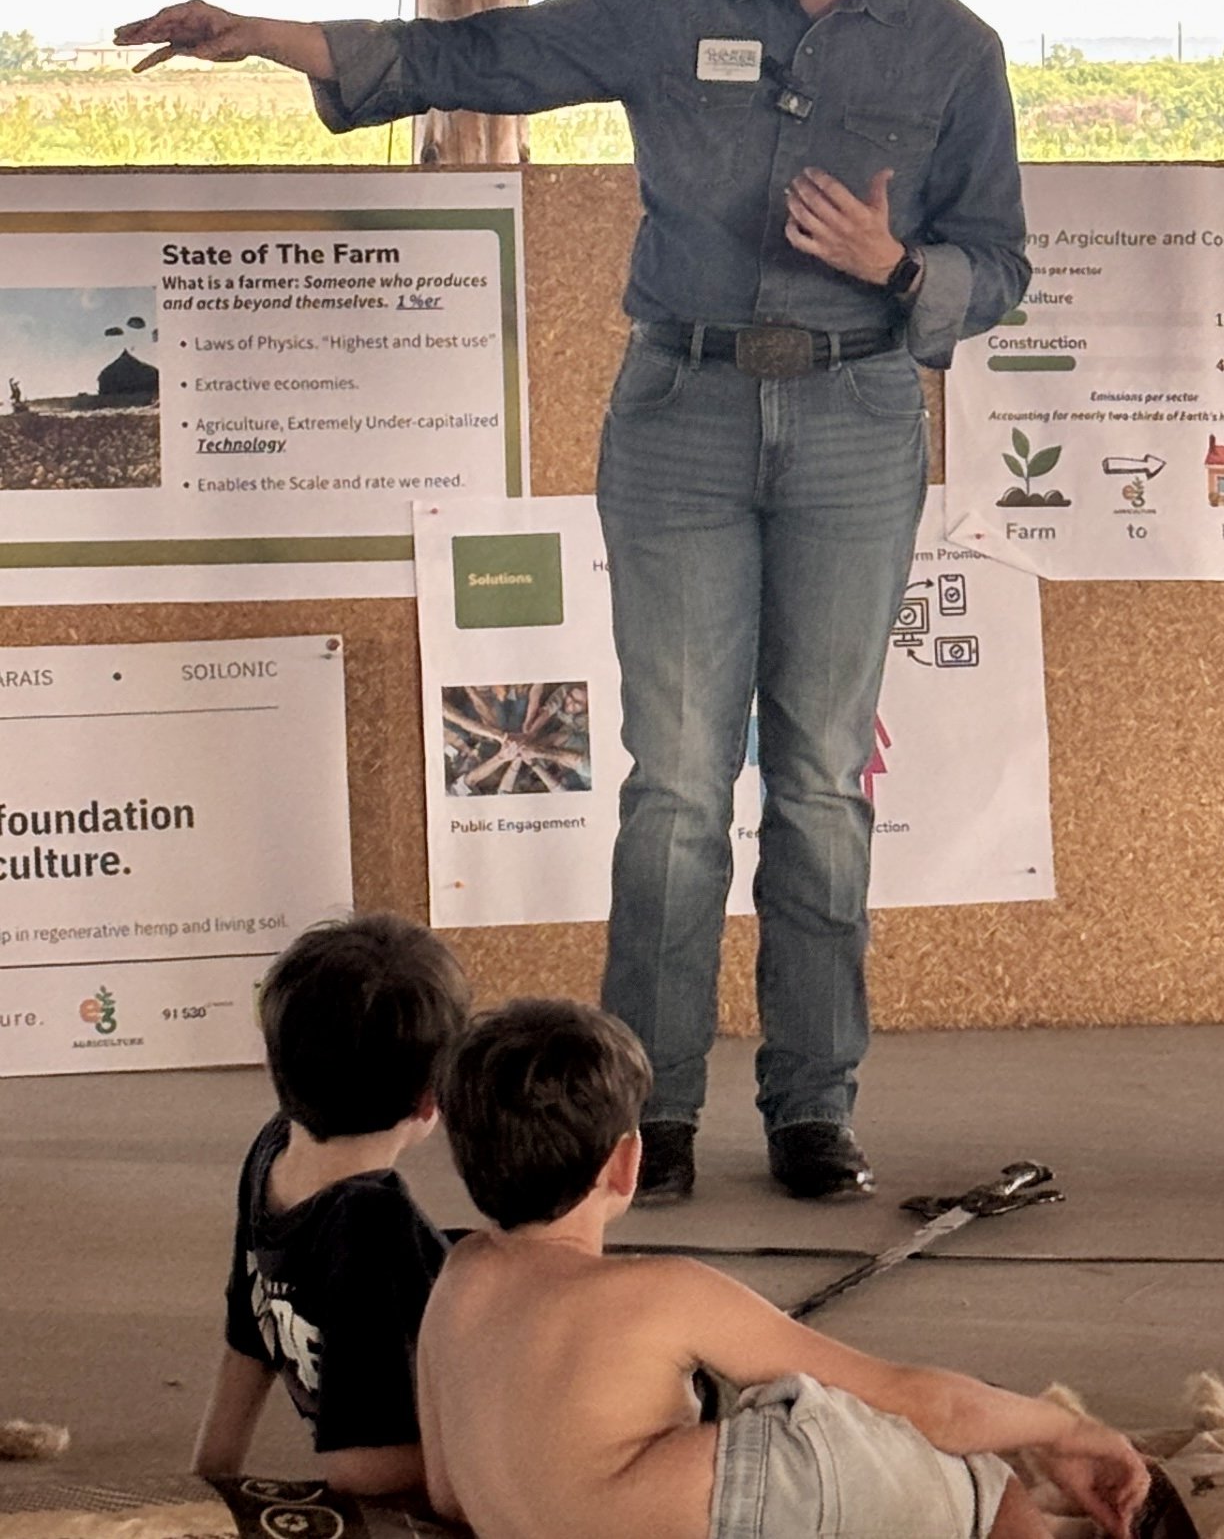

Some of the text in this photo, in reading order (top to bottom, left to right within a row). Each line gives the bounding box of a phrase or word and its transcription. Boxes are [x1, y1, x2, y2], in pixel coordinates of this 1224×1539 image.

[1055, 230, 1157, 249] Argiculture
[1162, 230, 1196, 247] and
[162, 243, 400, 265] State of The Farm
[1069, 265, 1103, 275] sector
[162, 274, 487, 291] What is a farmer: Someone who produces
[163, 296, 194, 311] and
[196, 297, 229, 310] acts
[233, 295, 291, 312] beyond
[295, 295, 389, 310] themselves.
[195, 337, 235, 351] Laws
[237, 336, 254, 351] of
[257, 336, 318, 354] Physics.
[392, 335, 421, 349] and
[425, 335, 459, 349] best
[988, 335, 1087, 350] Construction
[195, 377, 359, 392] Extractive economies.
[1090, 391, 1199, 405] Emissions per sector
[196, 413, 499, 436] Agriculture, Extremely Under-capitalized
[988, 410, 1050, 423] Accounting
[1052, 409, 1069, 423] for
[1071, 410, 1106, 423] nearly
[1166, 410, 1180, 422] of
[196, 438, 287, 454] Technology
[198, 474, 465, 492] Enables the Scale and rate we need.
[1006, 523, 1056, 541] Farm
[1127, 524, 1148, 540] to
[468, 572, 533, 587] Solutions
[182, 661, 278, 681] SOILONIC
[451, 816, 586, 834] Public Engagement
[15, 927, 30, 942] in
[34, 923, 130, 944] regenerative
[134, 921, 179, 939] hemp
[182, 918, 211, 934] and
[215, 916, 256, 934] living
